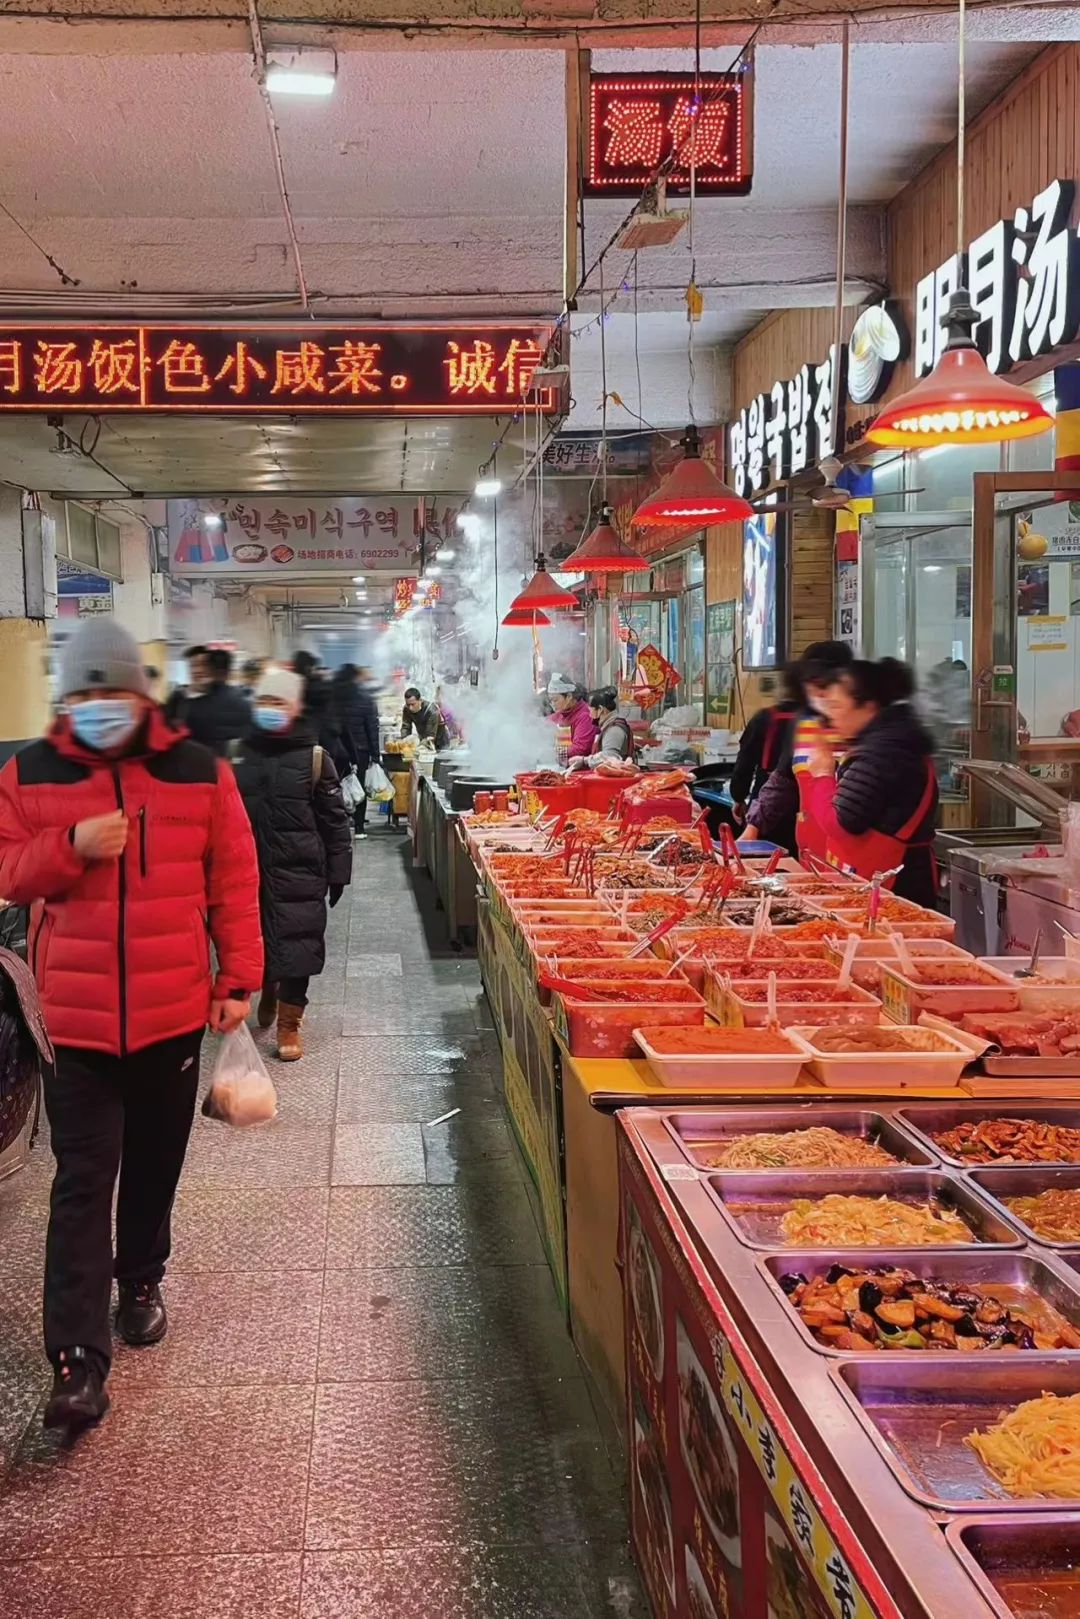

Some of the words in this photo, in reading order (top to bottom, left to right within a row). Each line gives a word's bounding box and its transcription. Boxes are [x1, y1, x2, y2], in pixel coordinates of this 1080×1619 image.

[143, 339, 408, 394] 色小咸菜。
[238, 507, 399, 540] 민속미식구역
